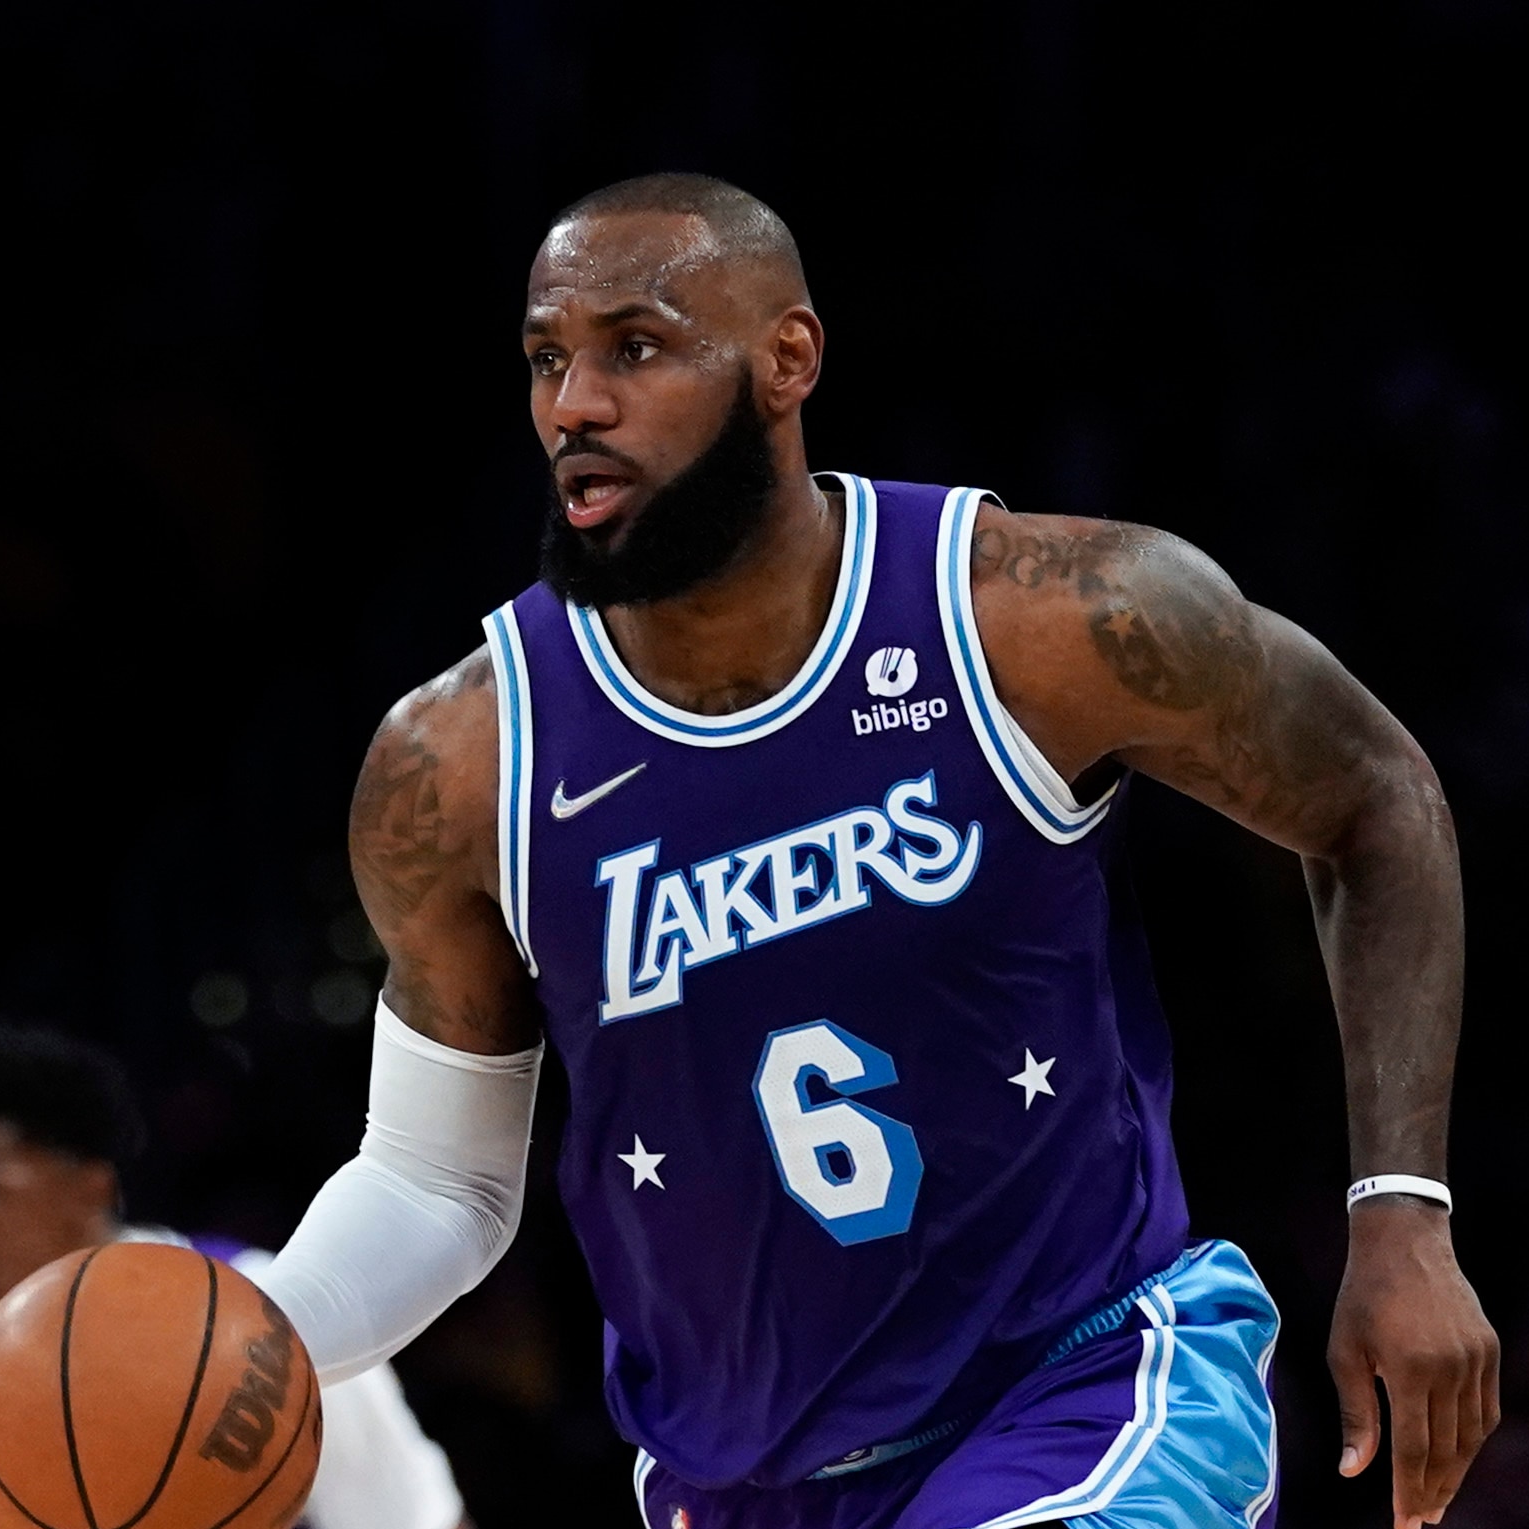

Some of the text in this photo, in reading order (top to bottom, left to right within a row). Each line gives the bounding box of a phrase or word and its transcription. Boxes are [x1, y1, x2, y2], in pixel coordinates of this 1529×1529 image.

[852, 696, 948, 736] bibigo
[593, 769, 983, 1027] LAKERS
[752, 1019, 924, 1246] 6
